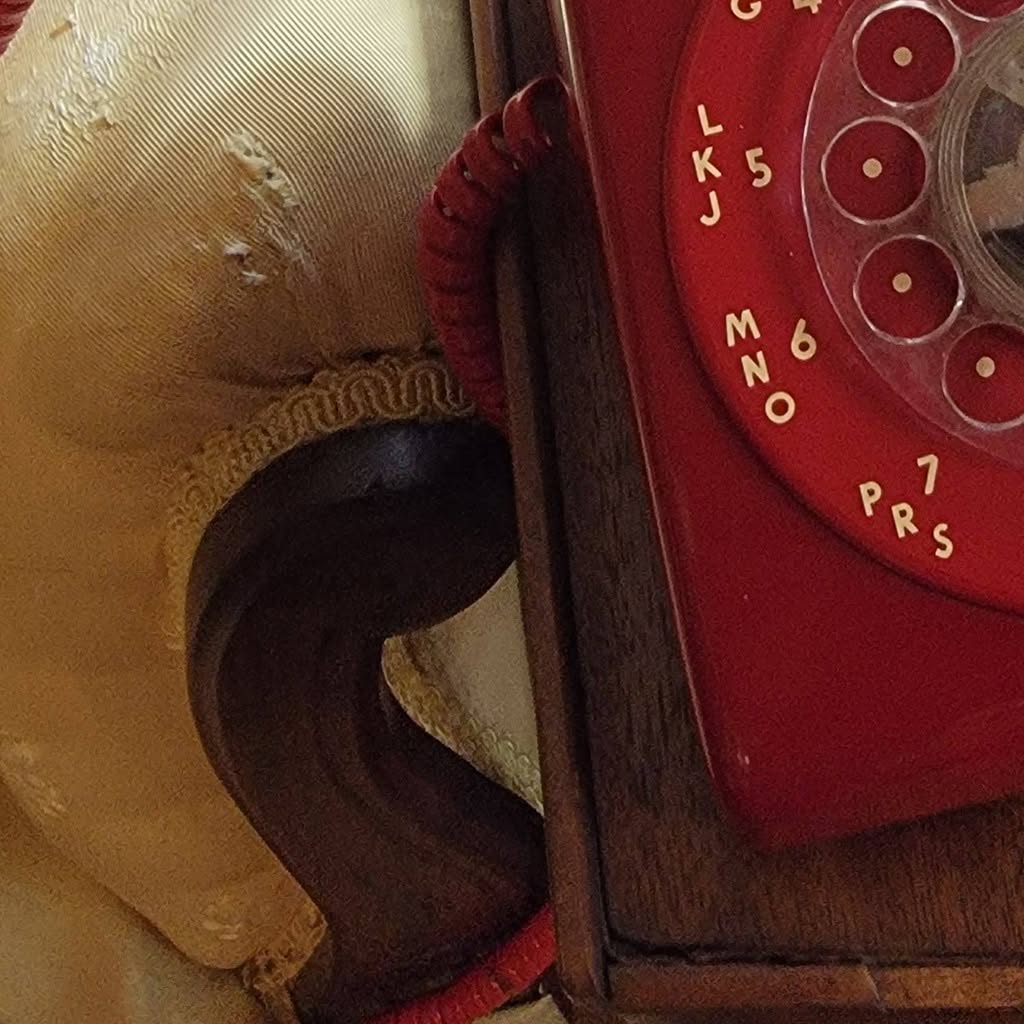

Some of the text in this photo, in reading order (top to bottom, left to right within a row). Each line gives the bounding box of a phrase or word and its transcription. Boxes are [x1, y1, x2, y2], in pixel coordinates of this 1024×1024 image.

[745, 147, 772, 188] 5
[790, 318, 817, 361] 6
[725, 308, 797, 424] MNO
[917, 454, 939, 495] 7
[859, 481, 954, 559] PRS
